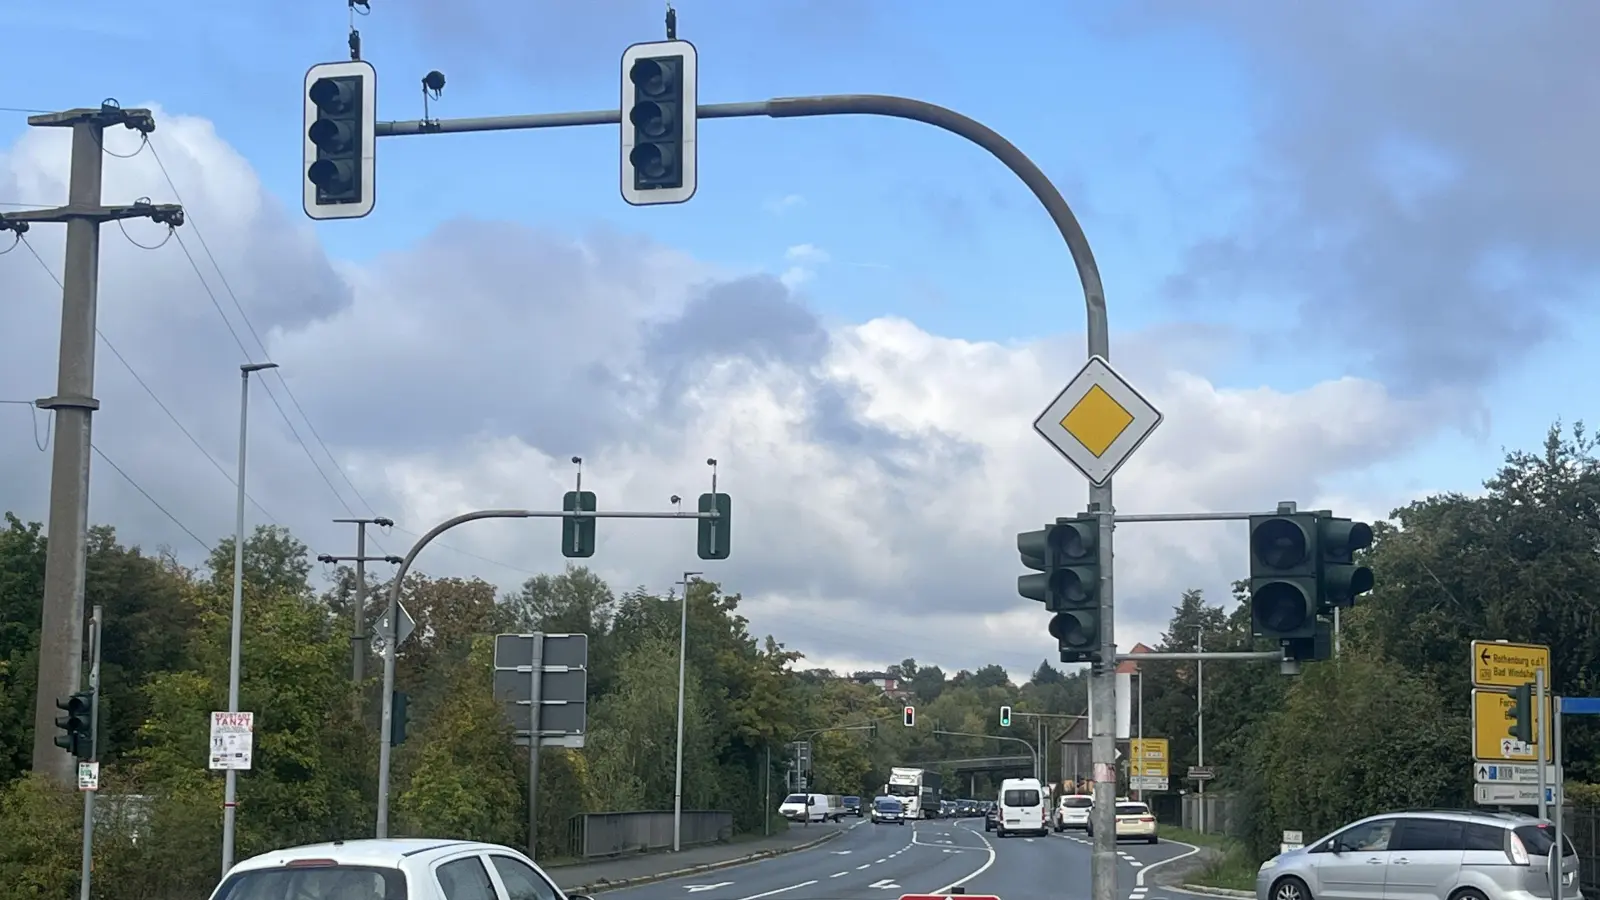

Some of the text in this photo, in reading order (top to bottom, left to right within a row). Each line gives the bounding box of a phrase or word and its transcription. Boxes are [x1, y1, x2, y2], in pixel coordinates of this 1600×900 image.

[1493, 654, 1529, 667] Rothenburg
[1493, 667, 1506, 677] Bad
[216, 718, 250, 726] TANZT
